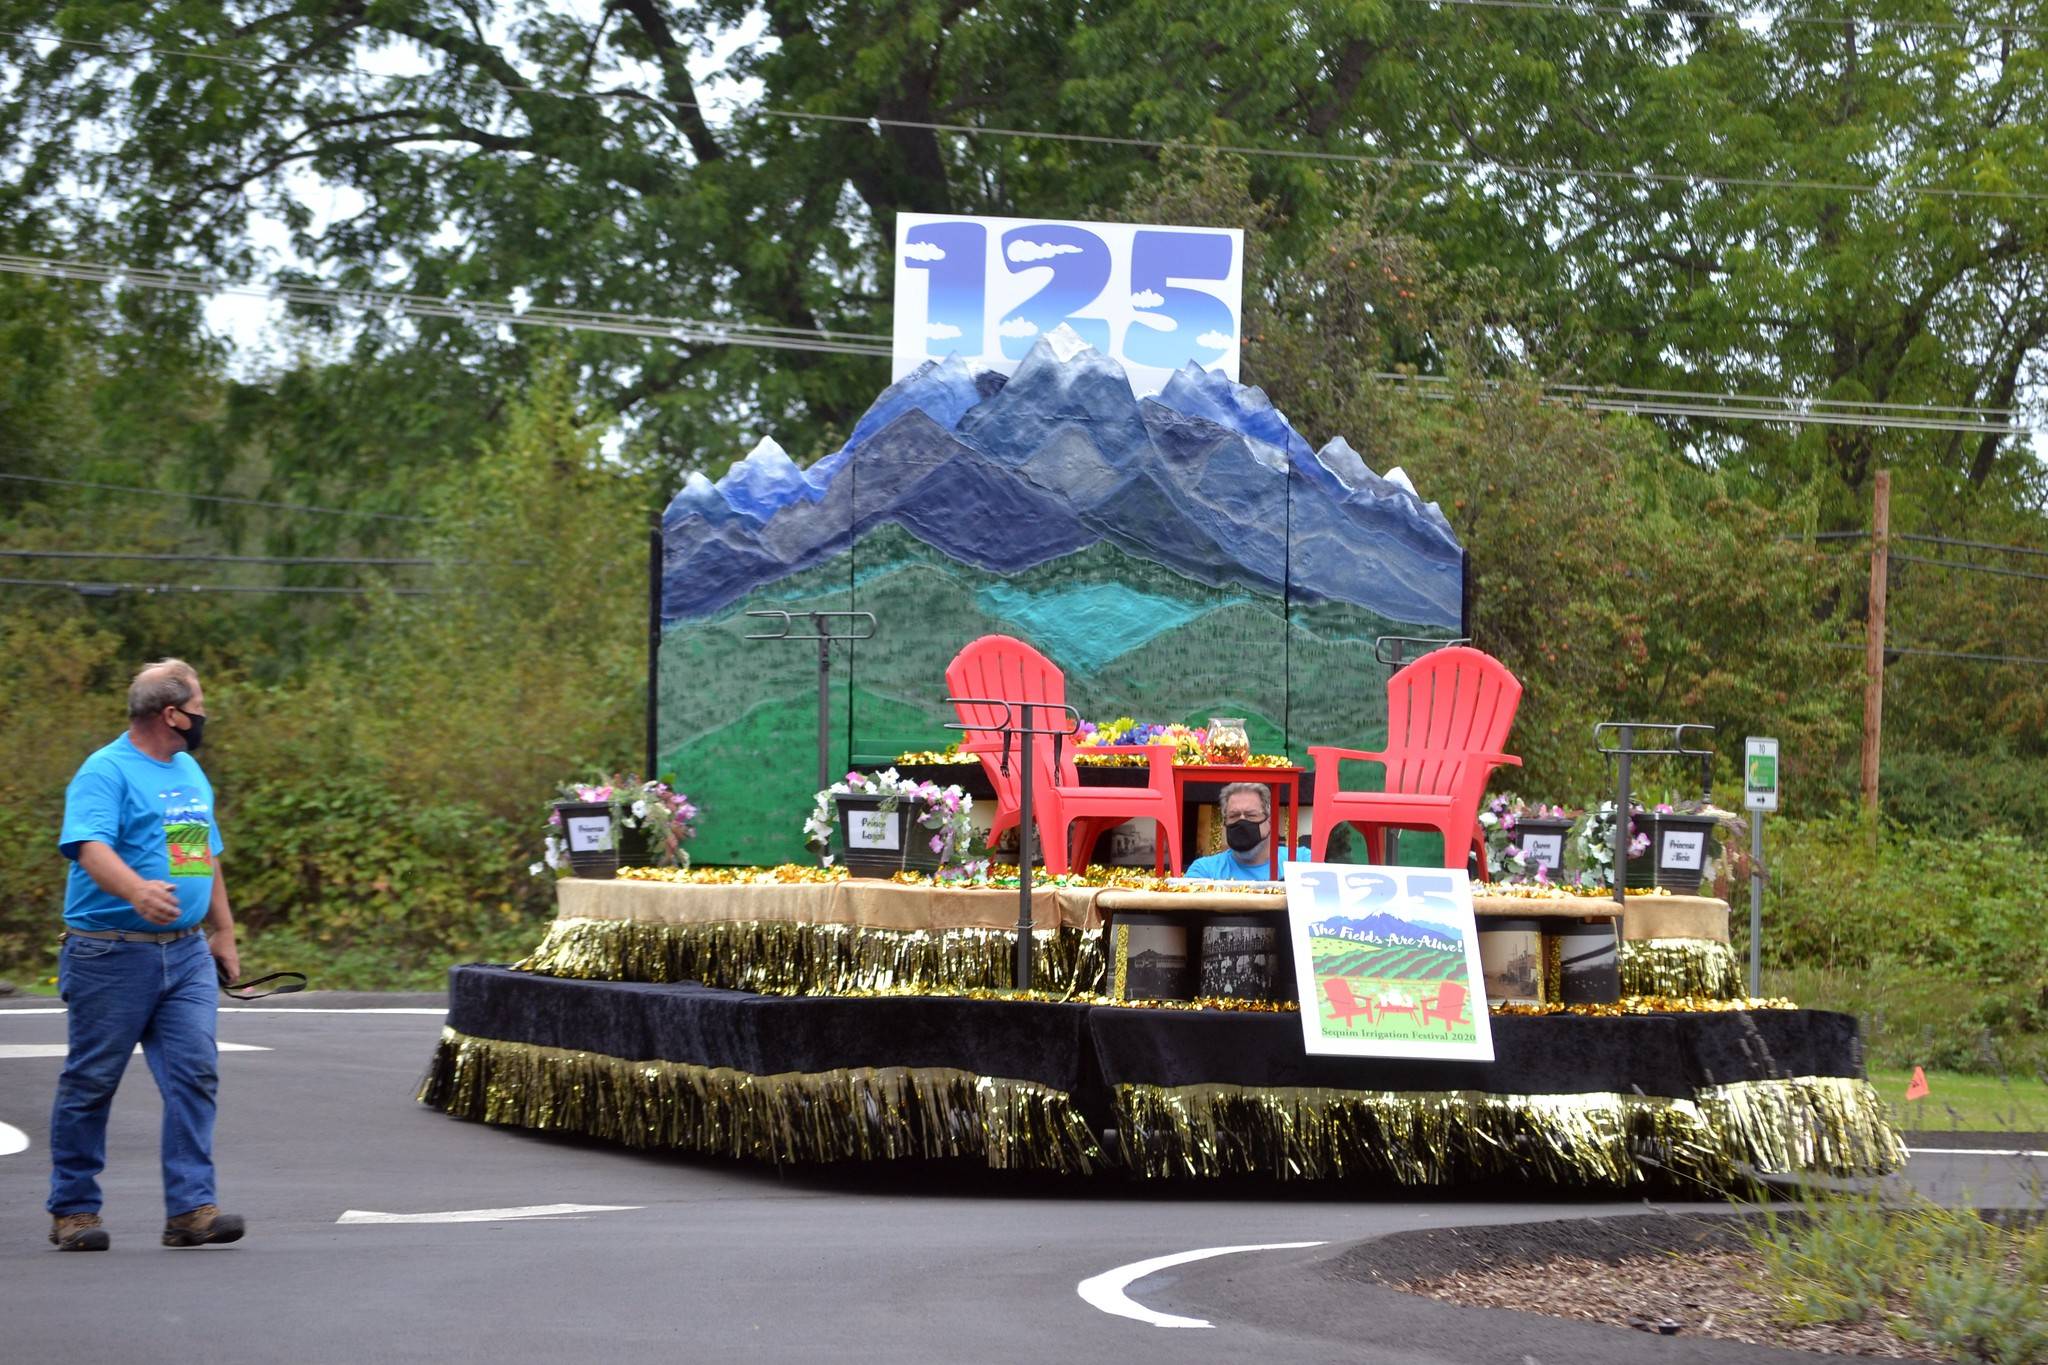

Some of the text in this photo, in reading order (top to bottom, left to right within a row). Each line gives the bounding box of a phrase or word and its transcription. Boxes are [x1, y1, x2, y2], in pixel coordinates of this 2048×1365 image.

[905, 222, 1234, 369] 125
[1669, 839, 1696, 849] Princess
[1301, 871, 1458, 913] 125
[1310, 922, 1464, 952] The Fields Are Alive!
[1321, 1027, 1476, 1041] Sequim Irrigation Festival 2020
